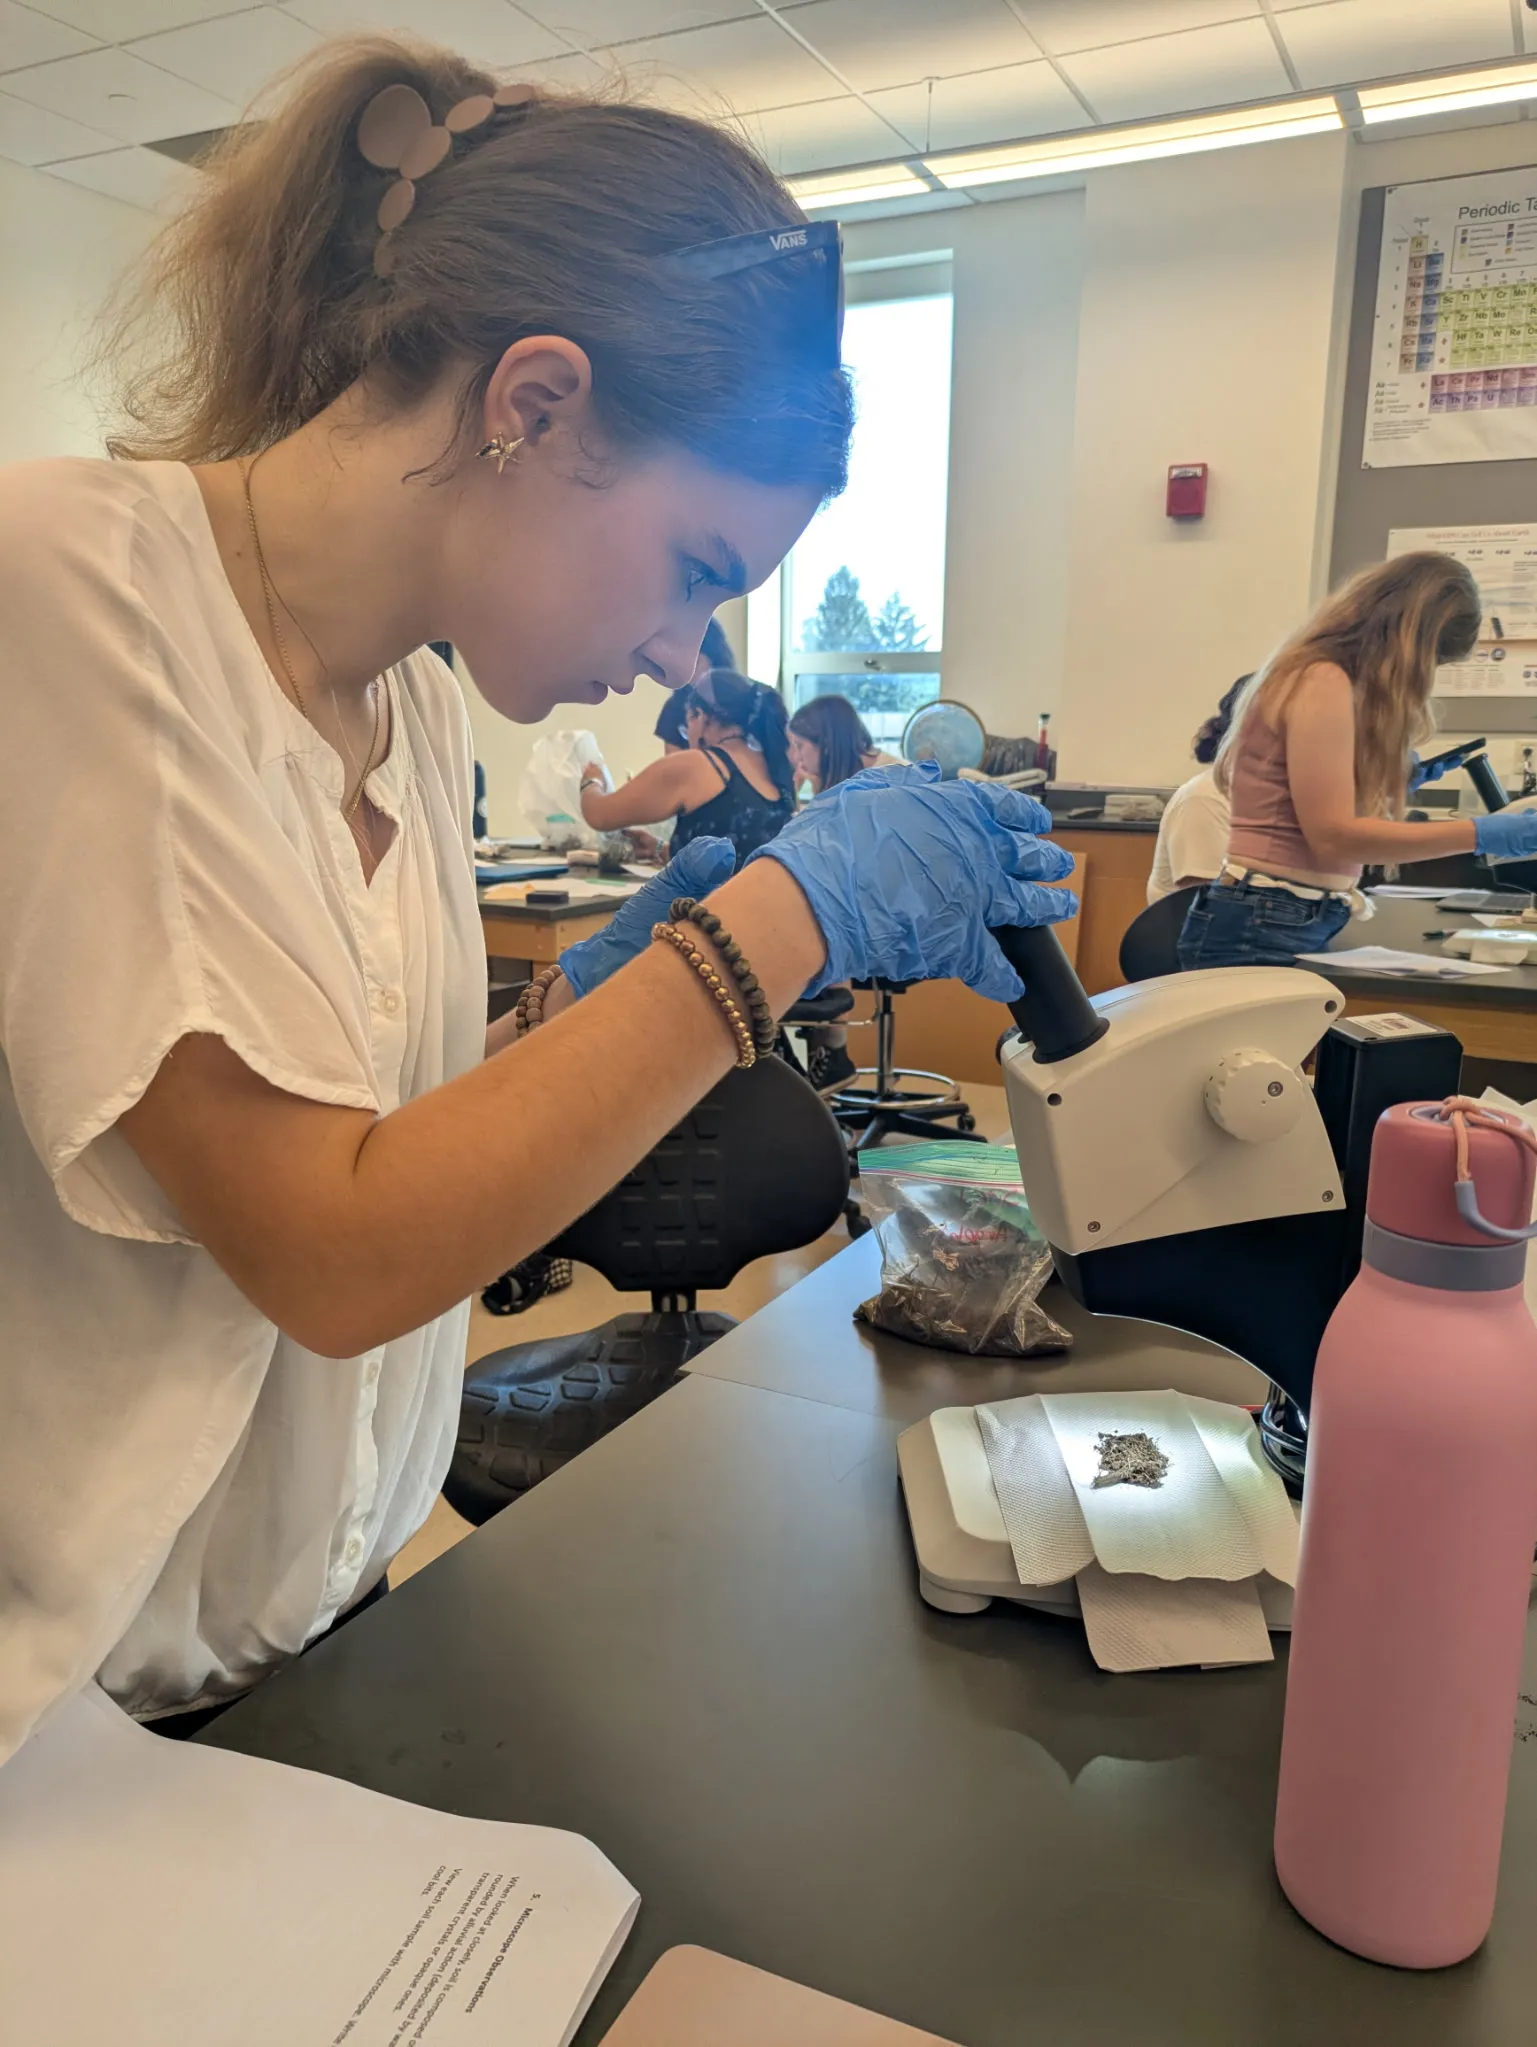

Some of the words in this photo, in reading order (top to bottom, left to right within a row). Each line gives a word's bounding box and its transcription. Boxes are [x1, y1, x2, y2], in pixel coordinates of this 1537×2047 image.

[1458, 200, 1520, 219] Periodic
[769, 229, 808, 251] VANS
[431, 1865, 446, 1881] cool
[444, 1868, 463, 1886] View
[421, 1881, 438, 1897] bits.
[432, 1886, 447, 1904] each
[456, 1872, 490, 1915] transparent
[480, 1873, 504, 1906] rounded
[500, 1875, 520, 1899] When
[530, 1892, 542, 1902] 5.
[421, 1905, 435, 1919] soil
[471, 1907, 485, 1917] by
[483, 1900, 505, 1926] looked
[402, 1920, 425, 1948] sample
[439, 1916, 460, 1945] crystals
[454, 1917, 476, 1946] alluvial
[477, 1926, 487, 1935] at
[500, 1907, 534, 1954] Microscope
[388, 1949, 405, 1967] with
[431, 1946, 441, 1956] or
[437, 1946, 458, 1973] action
[457, 1936, 481, 1966] closely,
[409, 1957, 434, 1989] opaque
[448, 1967, 461, 1983] soil
[465, 1955, 505, 2013] Observations
[352, 1968, 392, 2018] microscope.
[407, 1974, 442, 2019] (deposited
[443, 1983, 454, 1991] is
[392, 1989, 413, 2013] ones.
[398, 2020, 412, 2032] by
[413, 1992, 446, 2039] composed
[333, 2020, 358, 2045] Write
